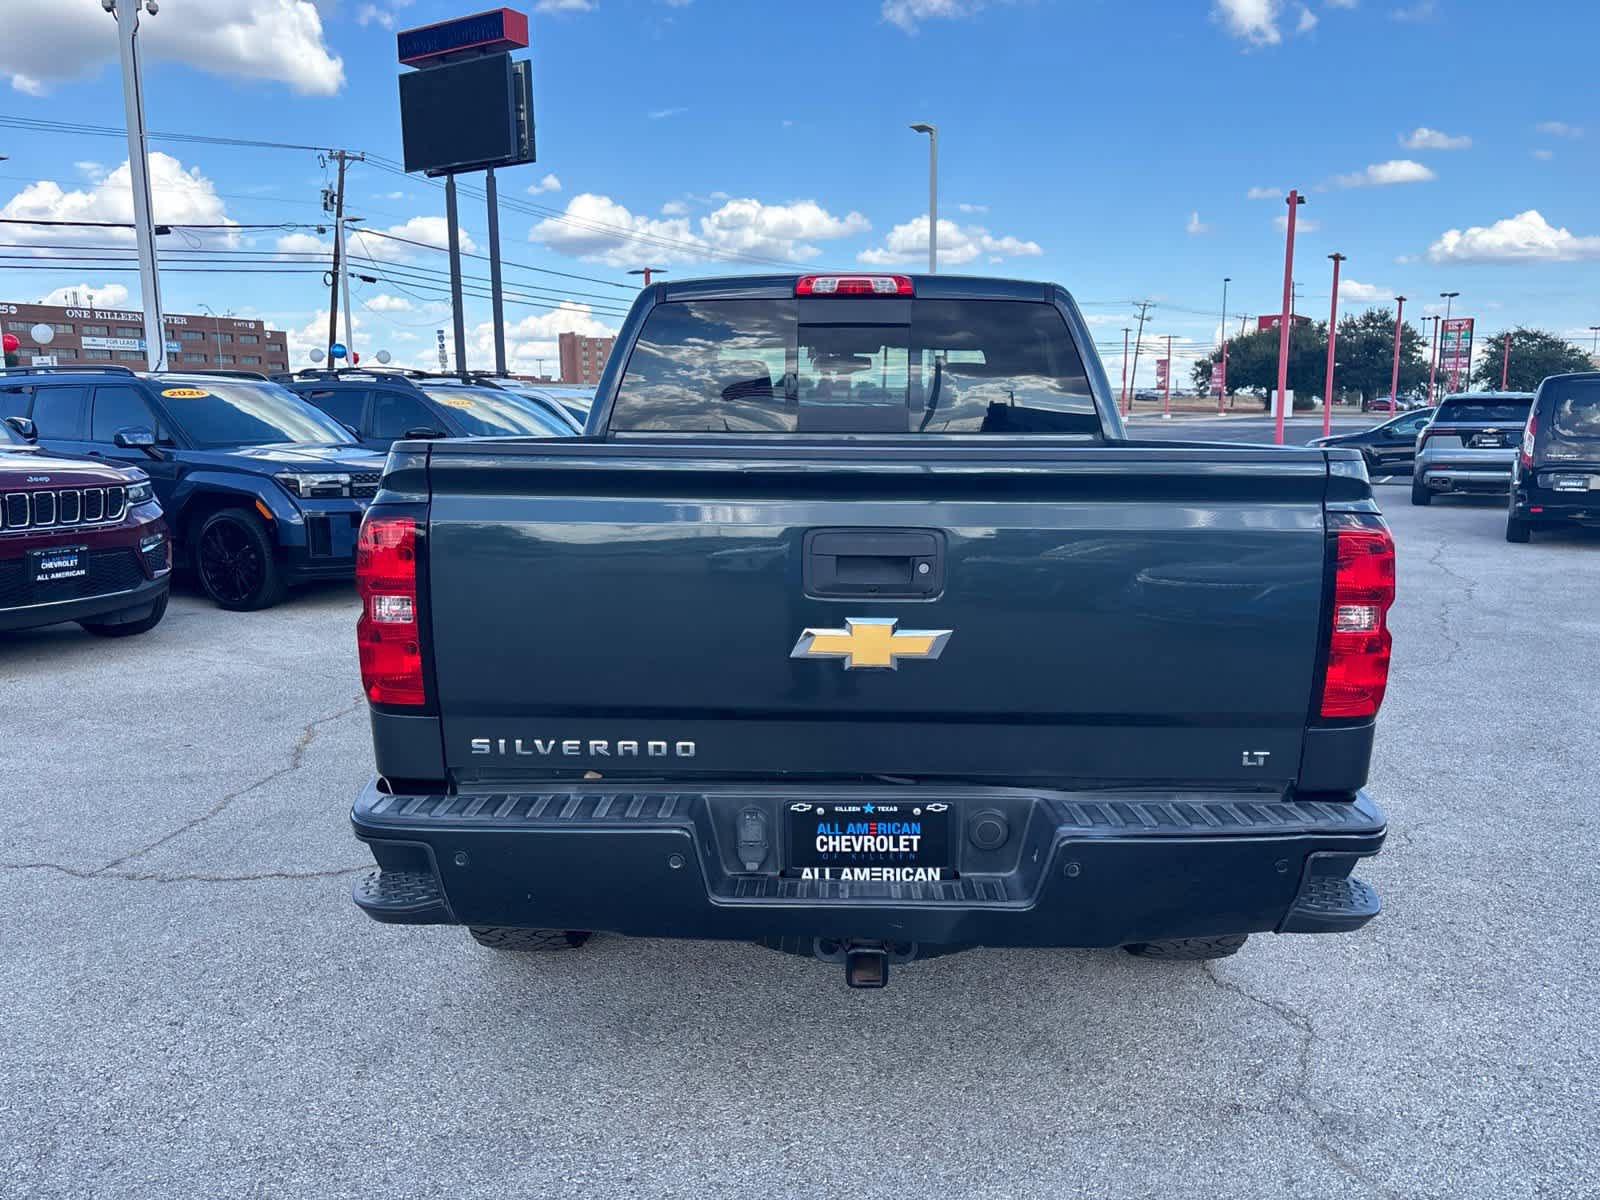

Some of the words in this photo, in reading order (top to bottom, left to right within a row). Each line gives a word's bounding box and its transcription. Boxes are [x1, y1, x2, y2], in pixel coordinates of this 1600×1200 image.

[65, 309, 91, 319] ONE
[95, 311, 143, 322] KILLEEN
[41, 559, 78, 570] CHEVROLET
[50, 569, 86, 579] AMERICAN
[471, 738, 696, 757] SILVERADO
[1242, 751, 1271, 767] LT
[817, 822, 843, 835] ALL
[846, 822, 921, 835] AMERICAN
[816, 835, 921, 852] CHEVROLET
[840, 867, 941, 882] AMERICAN
